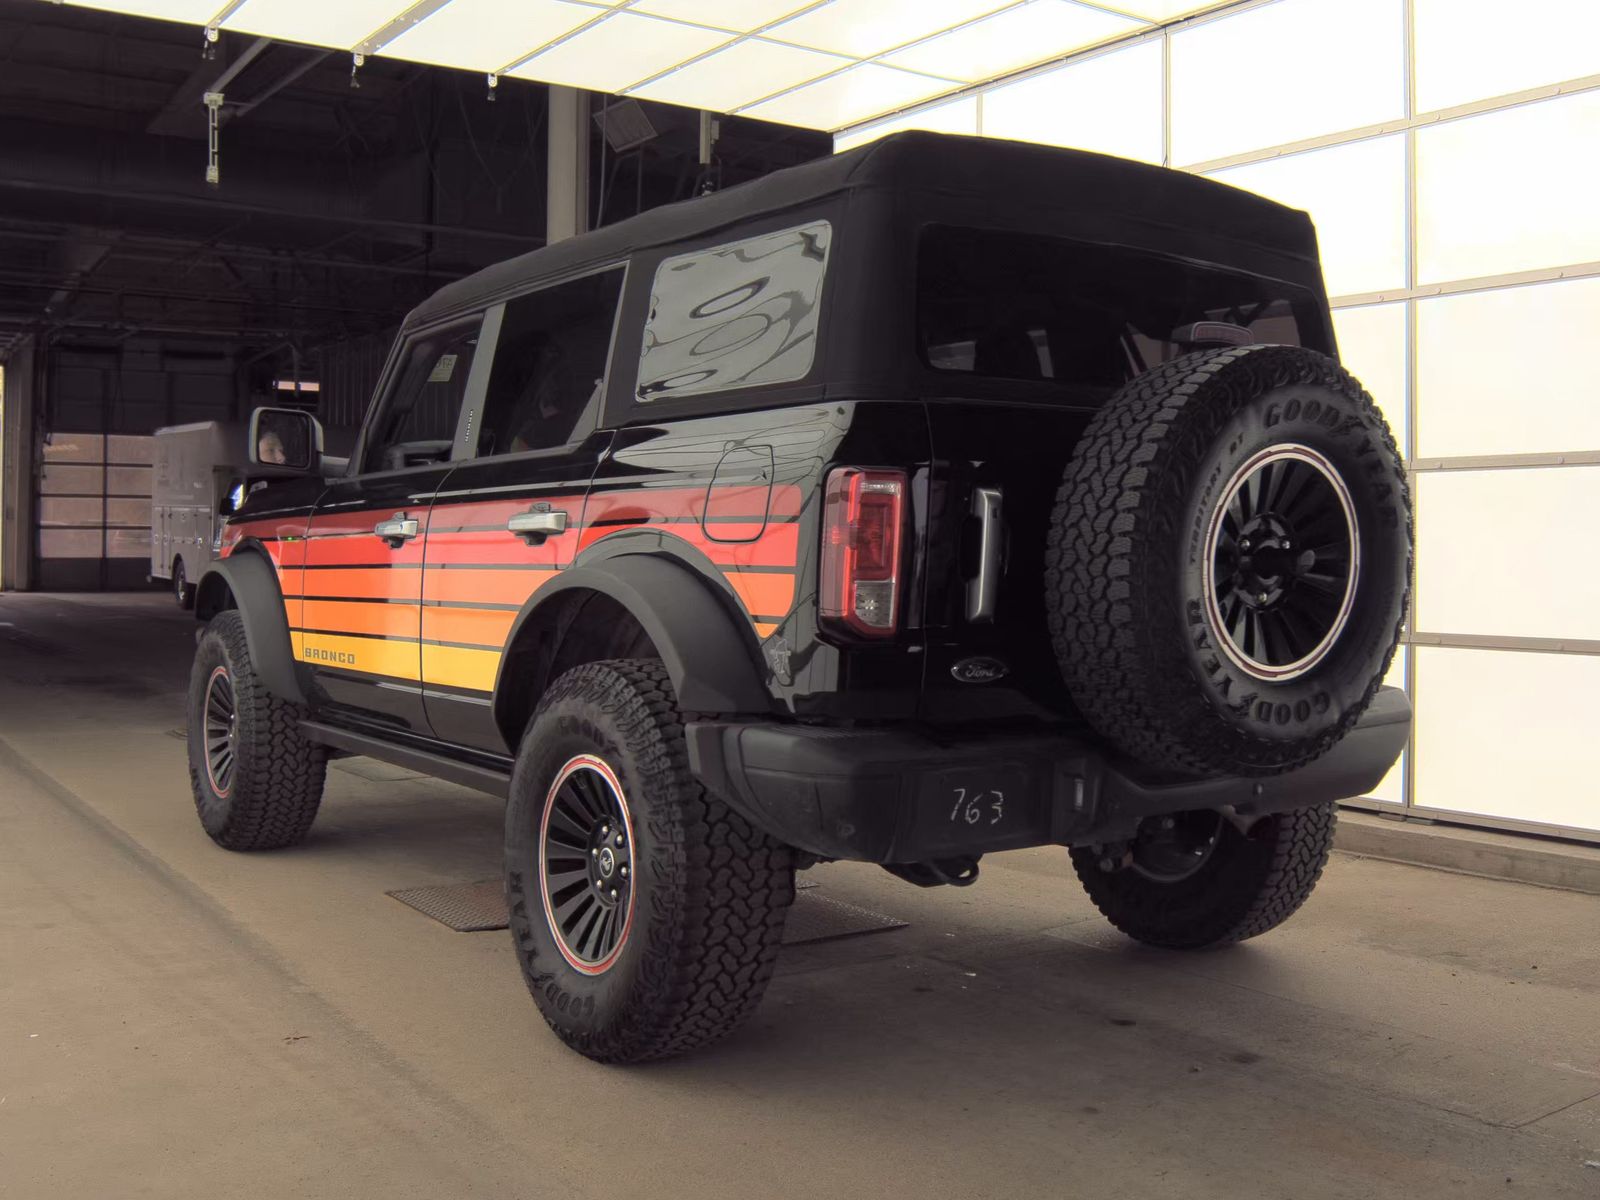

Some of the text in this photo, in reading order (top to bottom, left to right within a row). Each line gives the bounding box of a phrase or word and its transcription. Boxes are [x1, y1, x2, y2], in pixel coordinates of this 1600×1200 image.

[305, 647, 355, 664] BRONCO
[965, 664, 994, 679] Ford
[951, 788, 1004, 824] 763
